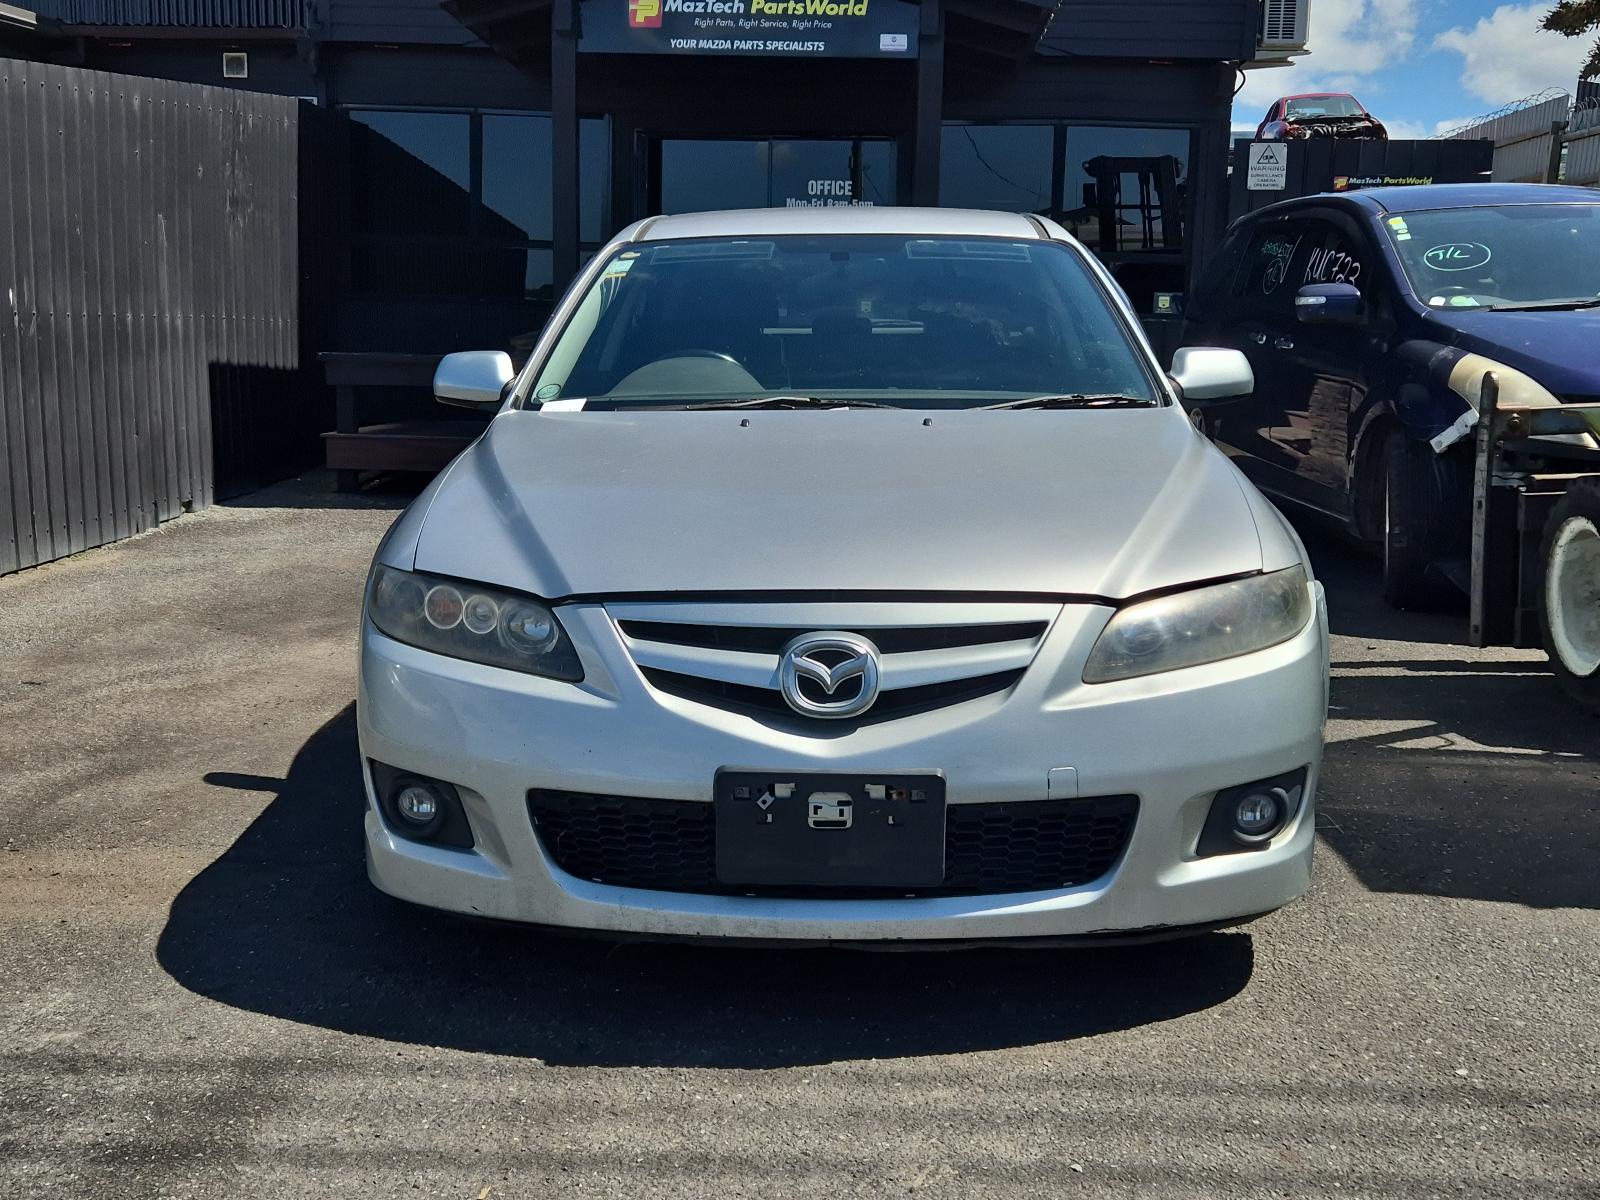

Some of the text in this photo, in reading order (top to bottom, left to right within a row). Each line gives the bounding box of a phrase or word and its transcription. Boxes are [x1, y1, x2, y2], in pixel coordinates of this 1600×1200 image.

[664, 0, 868, 16] MazTech PartsWorld
[694, 18, 833, 30] Right Parts, Right Service, Right Price
[670, 39, 825, 51] YOUR MAZDA PARTS SPECIALISTS
[1384, 177, 1433, 185] PartsWorld
[807, 180, 853, 196] OFFICE
